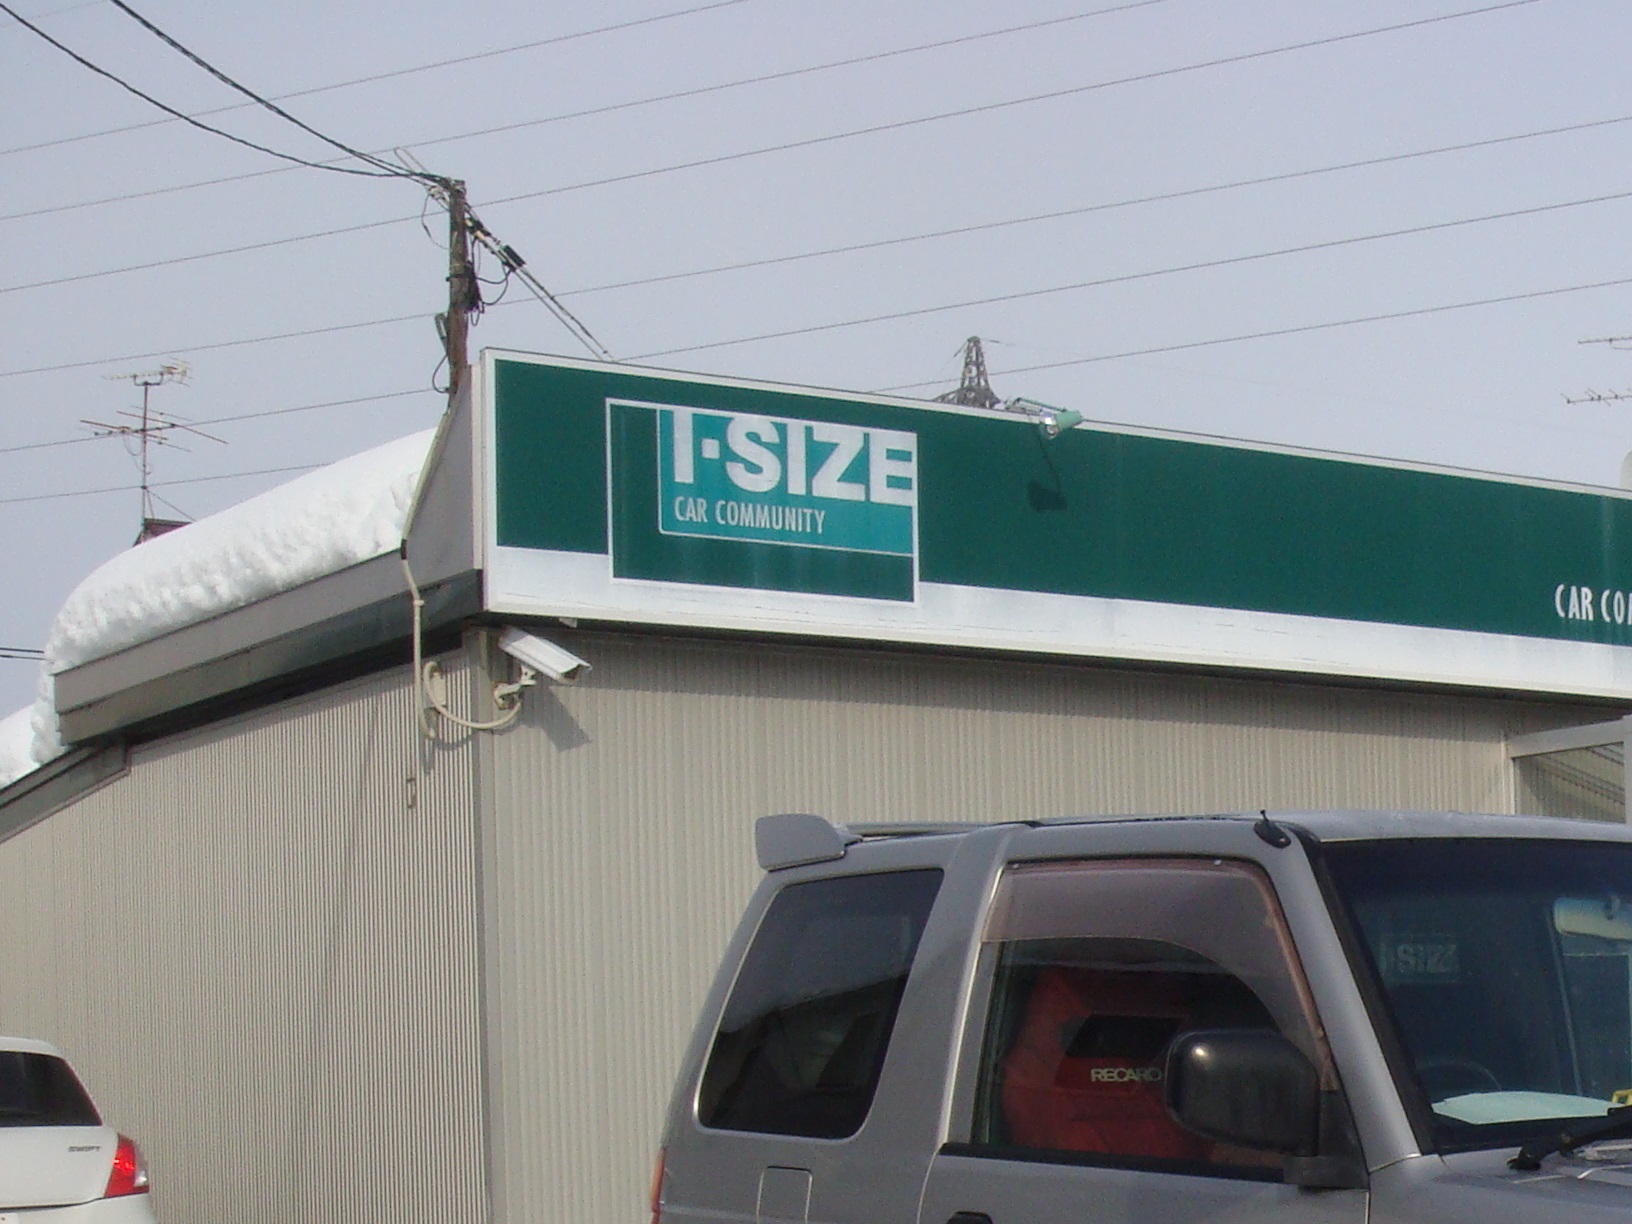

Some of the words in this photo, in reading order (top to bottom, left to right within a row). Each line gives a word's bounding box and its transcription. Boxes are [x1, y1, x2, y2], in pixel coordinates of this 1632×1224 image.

[674, 496, 708, 523] CAR
[715, 500, 826, 534] COMMUNITY
[1554, 584, 1594, 622] CAR
[1090, 1067, 1163, 1082] RECARO
